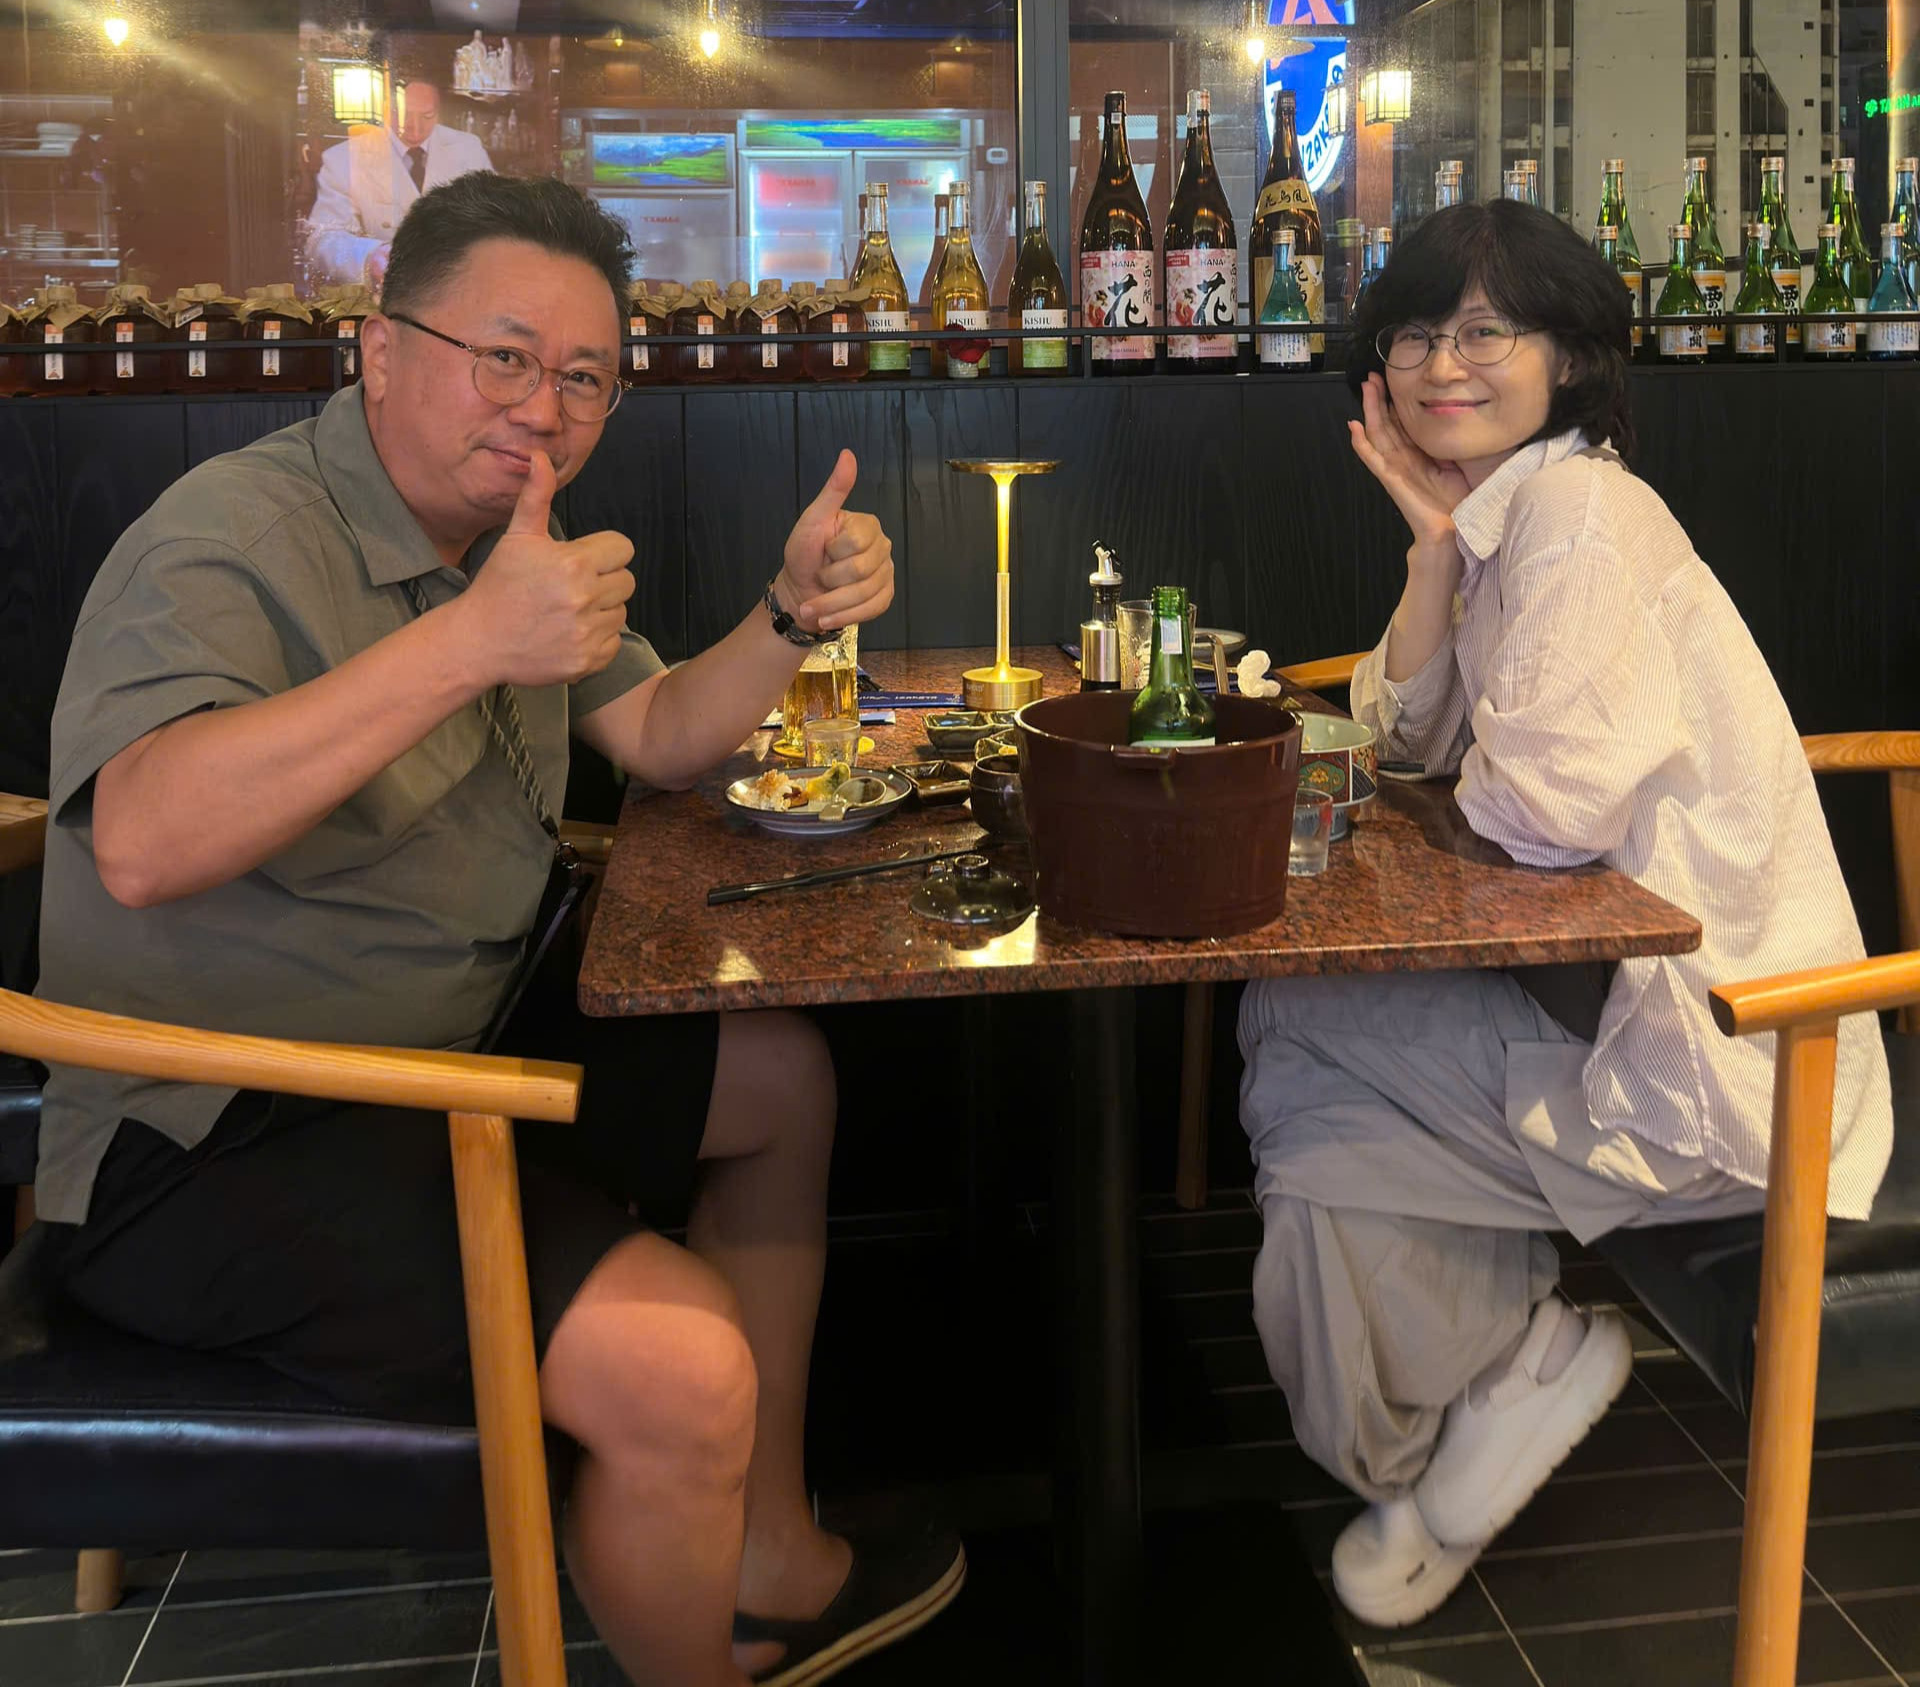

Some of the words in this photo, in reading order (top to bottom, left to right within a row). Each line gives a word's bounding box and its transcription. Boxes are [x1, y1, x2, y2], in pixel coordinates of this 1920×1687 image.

[1111, 260, 1136, 268] HANA
[1200, 258, 1224, 266] HANA
[1103, 273, 1149, 327] 花
[1192, 271, 1235, 326] 花
[1024, 317, 1051, 325] KISHU
